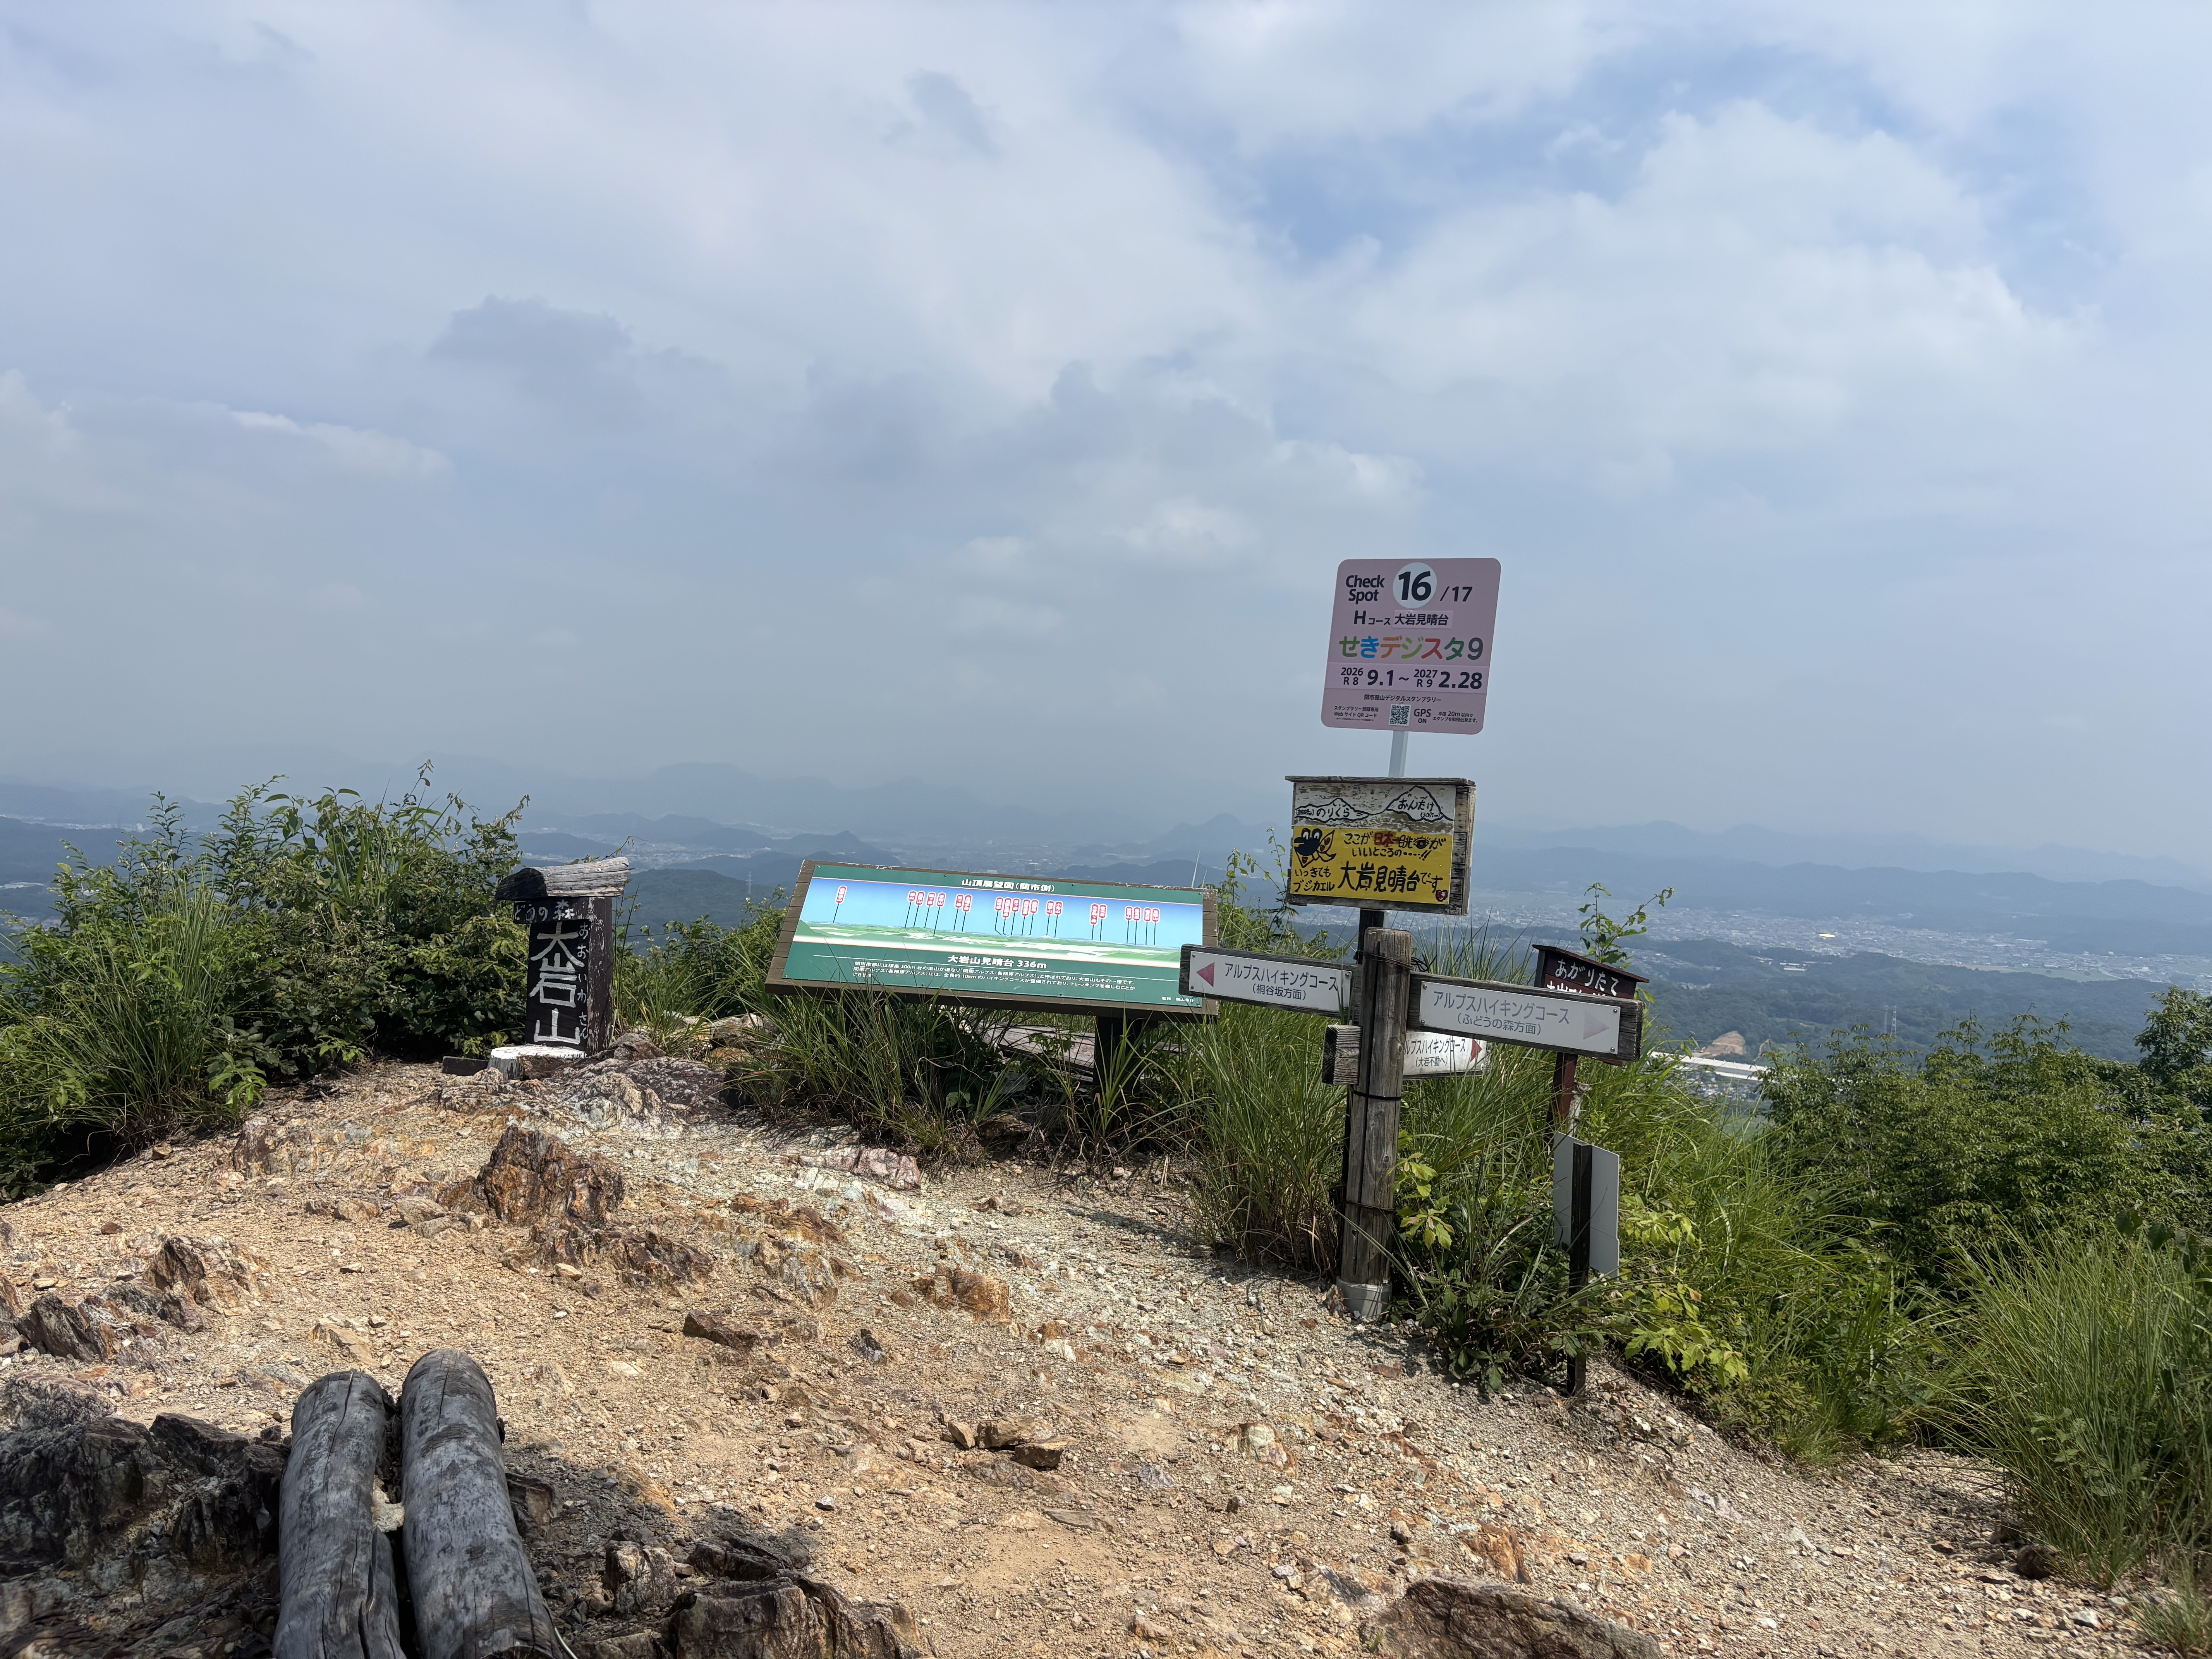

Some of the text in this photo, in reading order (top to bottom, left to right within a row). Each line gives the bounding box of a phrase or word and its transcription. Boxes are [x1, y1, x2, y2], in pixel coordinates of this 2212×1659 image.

[1346, 575, 1385, 588] Check
[1398, 571, 1431, 601] 16
[1348, 589, 1379, 604] Spot
[1394, 613, 1449, 626] 大岩見晴台
[1339, 635, 1483, 661] せきデジスタ9
[1341, 667, 1363, 676] 2026
[1367, 670, 1394, 686] 9.1
[1413, 669, 1437, 678] 2027
[1438, 672, 1482, 689] 2.28
[1414, 709, 1431, 717] GPS
[1317, 807, 1350, 818] のりくら
[1398, 798, 1435, 812] おんたけ
[947, 954, 1047, 969] 大岩山見晴台 336m
[530, 922, 585, 1044] 大岩山
[1225, 963, 1338, 991] アルプスハイキングコース
[1555, 959, 1620, 996] あがりたて
[1434, 991, 1570, 1024] アルプスハイキングコース
